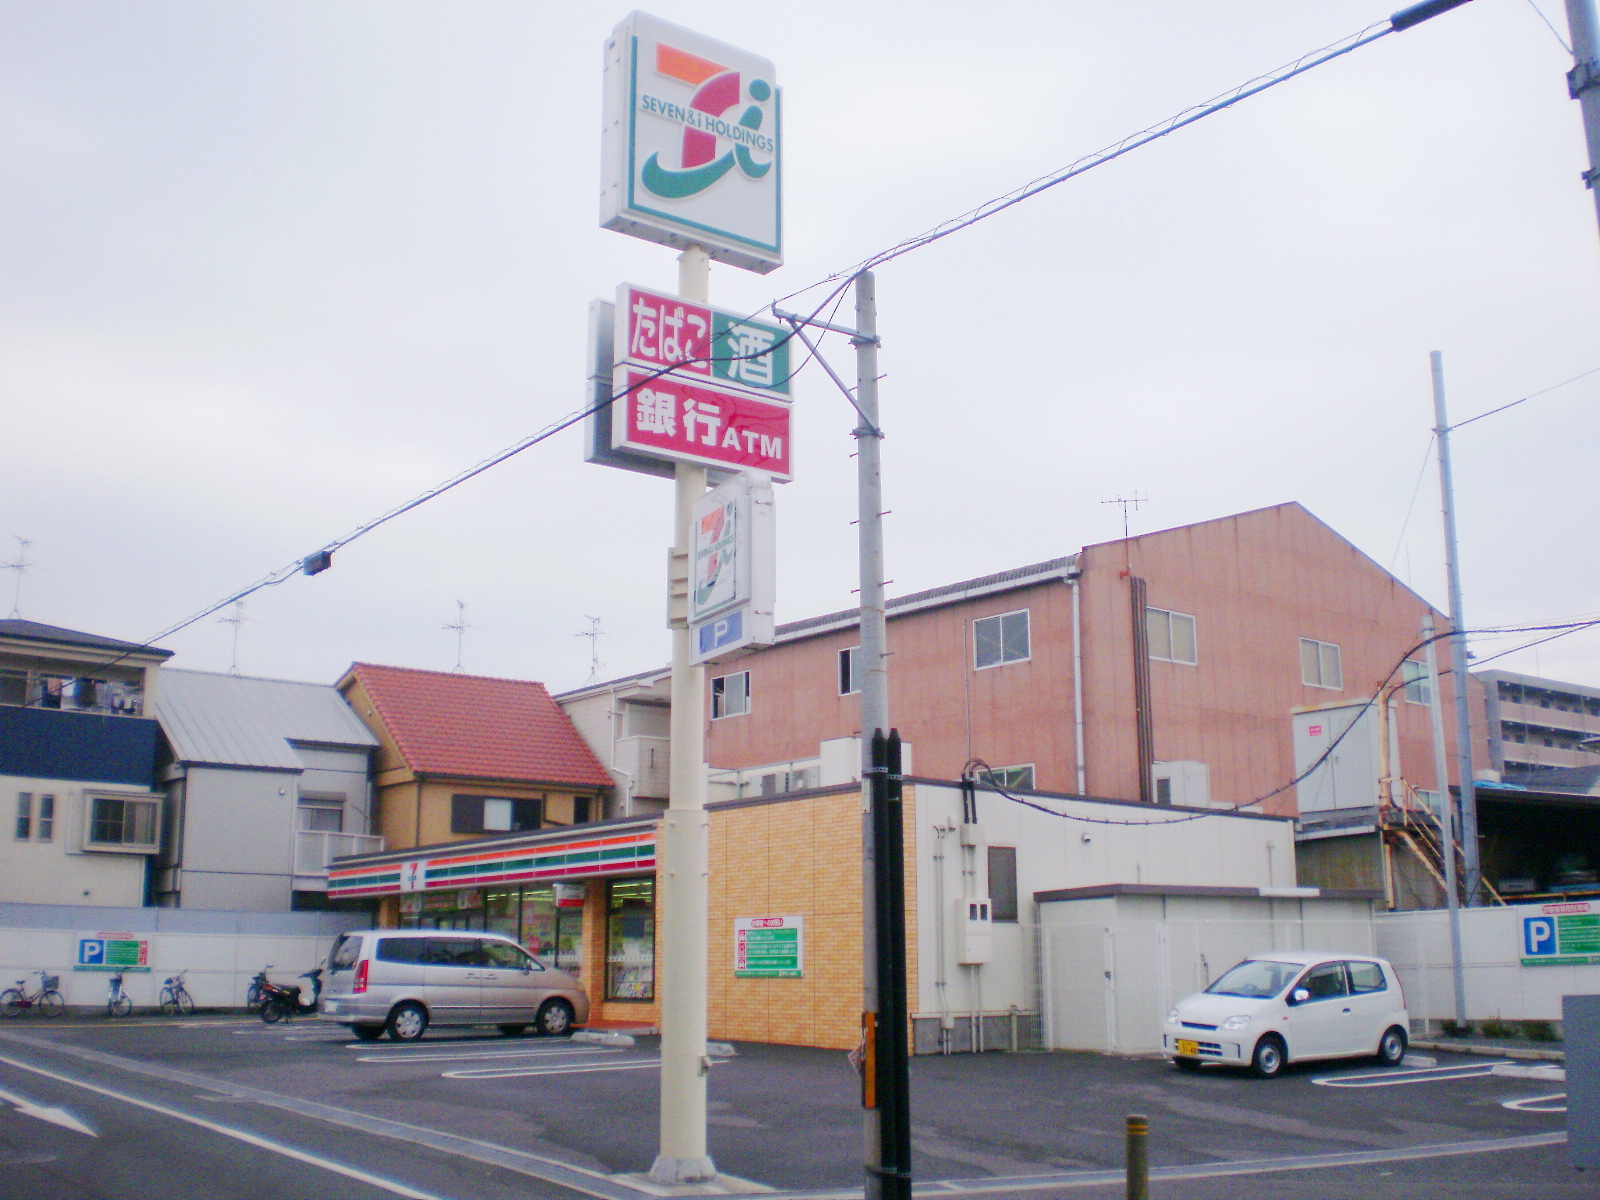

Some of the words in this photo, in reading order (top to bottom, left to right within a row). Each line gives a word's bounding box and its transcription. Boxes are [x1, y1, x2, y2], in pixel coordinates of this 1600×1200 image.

[705, 116, 774, 153] HOLDINGS
[631, 298, 708, 368] たばこ
[727, 321, 775, 385] 酒
[714, 620, 728, 647] P
[84, 942, 101, 962] P
[1530, 921, 1551, 953] P
